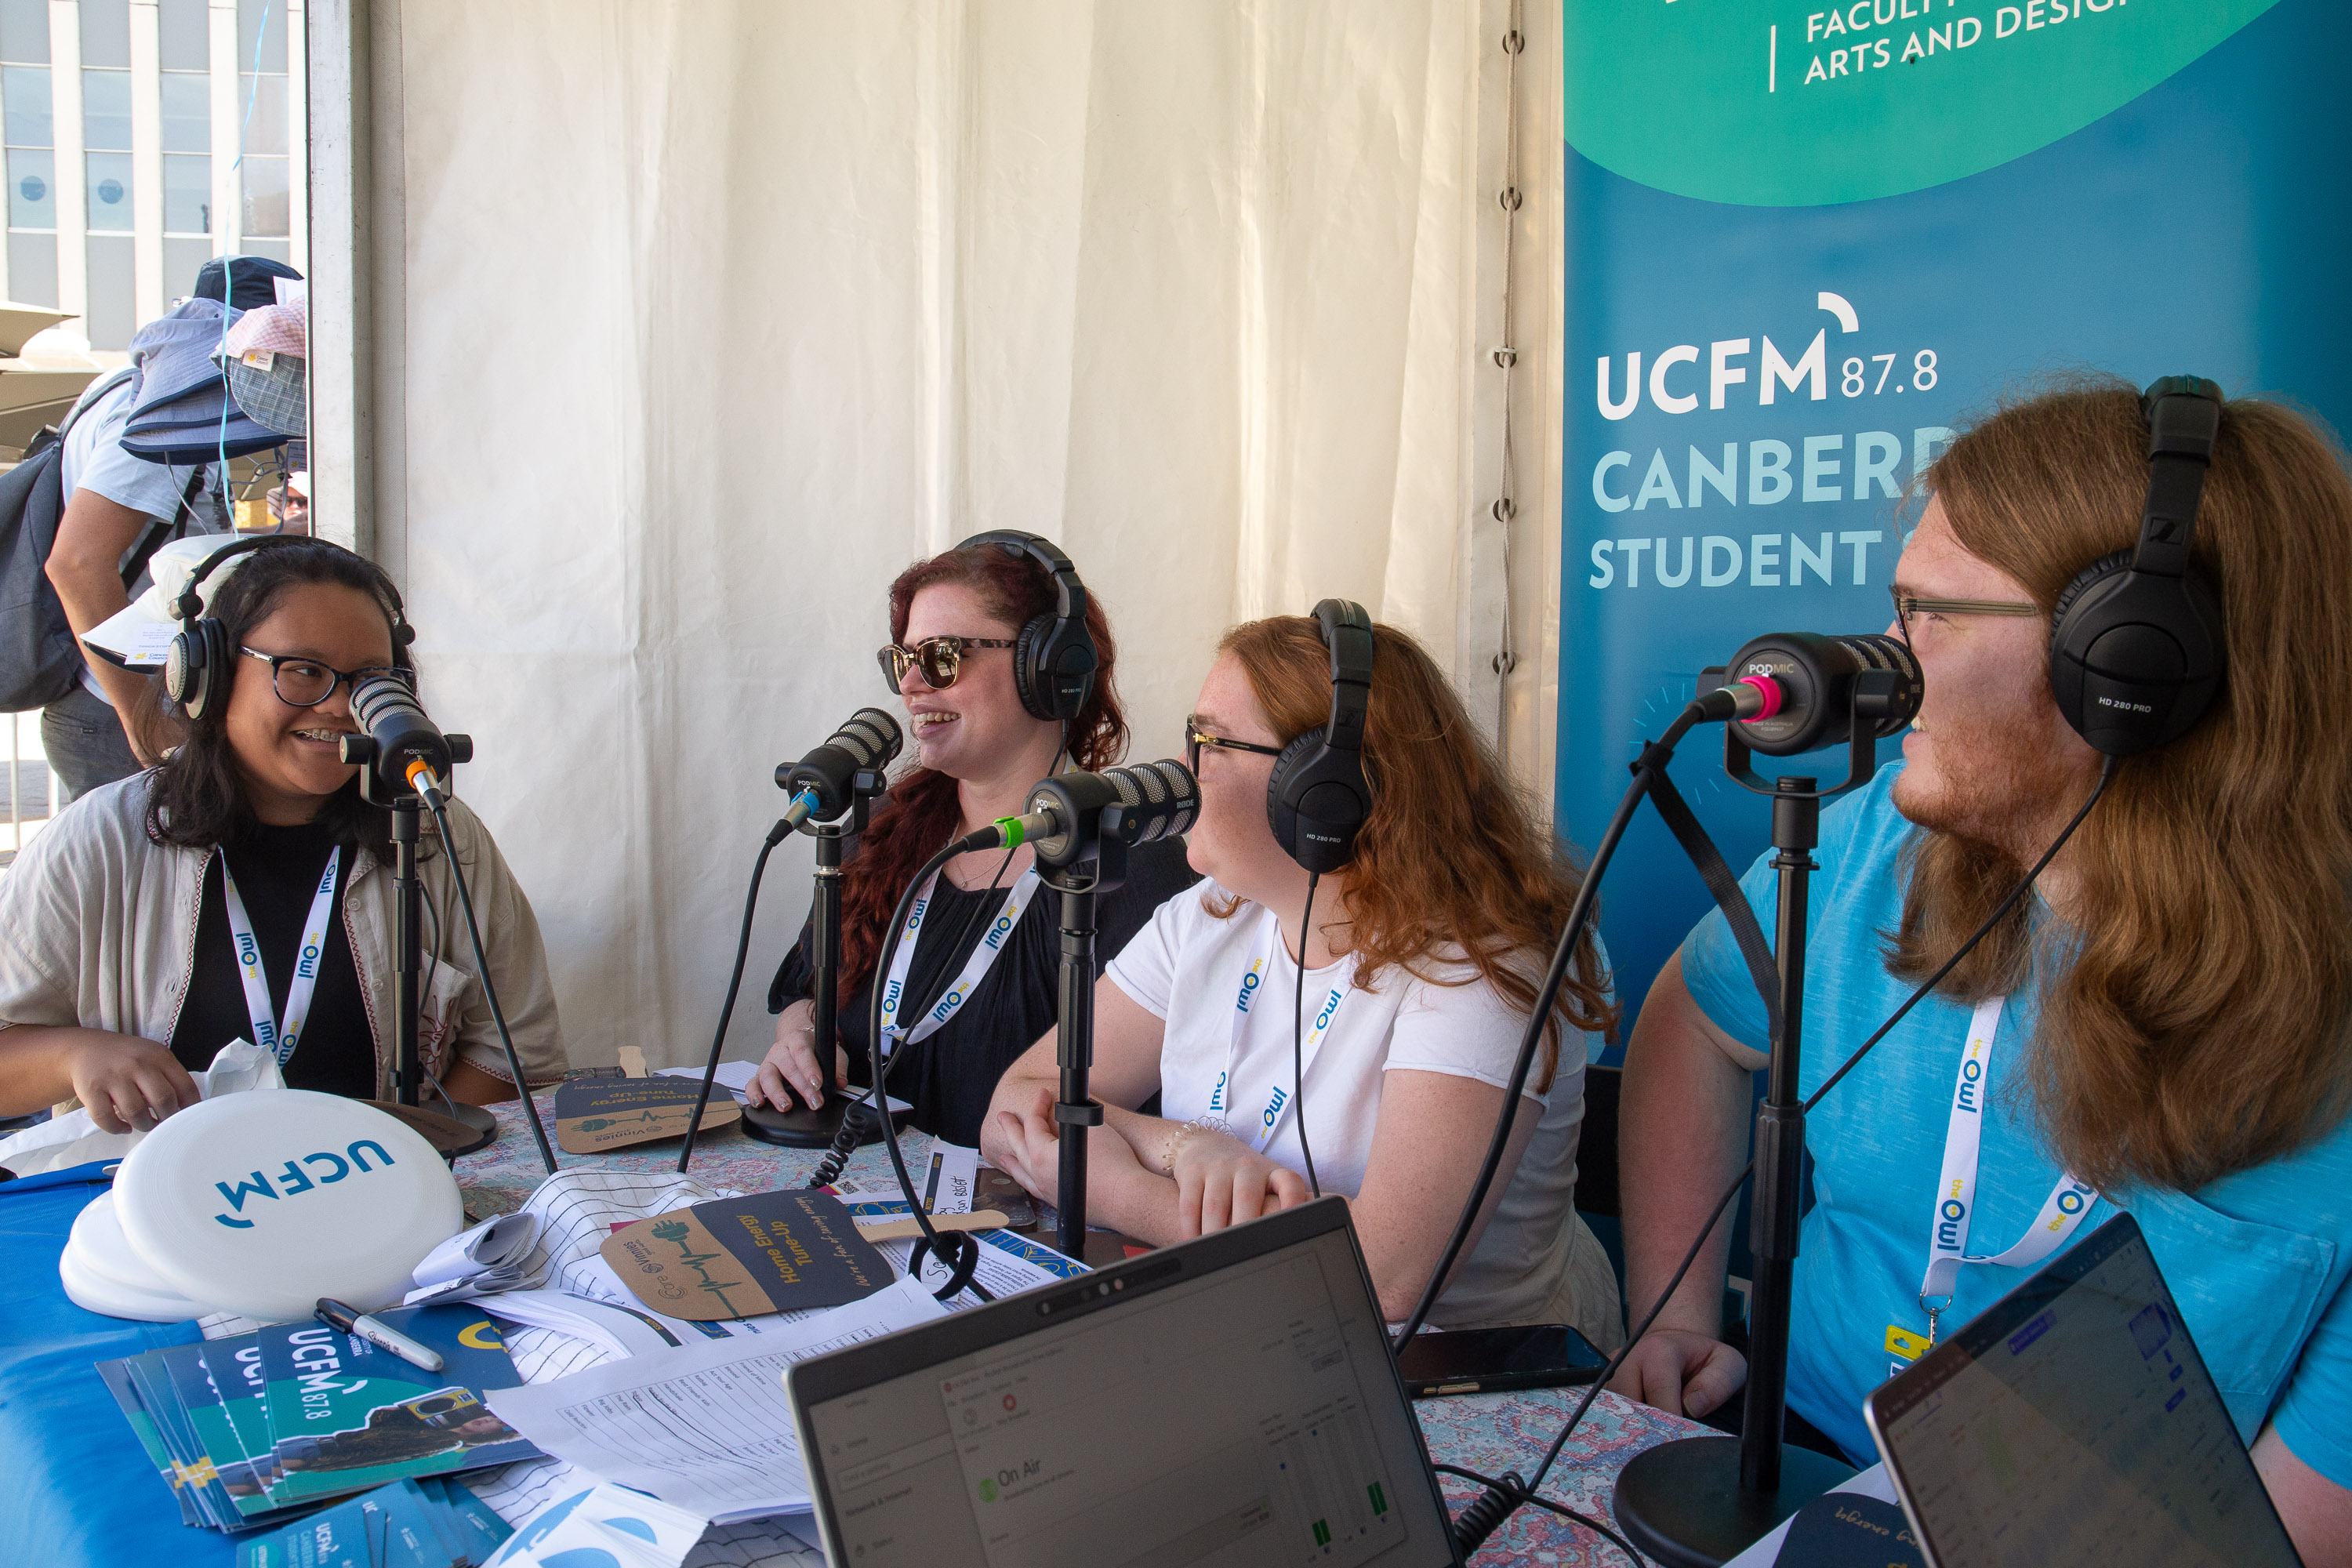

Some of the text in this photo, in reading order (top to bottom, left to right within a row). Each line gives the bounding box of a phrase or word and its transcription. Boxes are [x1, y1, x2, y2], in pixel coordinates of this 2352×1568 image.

[1805, 38, 1890, 85] ARTS
[1900, 16, 1982, 64] AND
[1597, 328, 1937, 420] UCFM 87.8
[1589, 530, 1882, 589] STUDENT
[1749, 663, 1795, 674] PODMIC
[2099, 697, 2151, 713] HD 280 PRO
[1036, 798, 1059, 809] PODMIC
[319, 864, 336, 894] Owl
[908, 899, 927, 930] Owl
[236, 932, 258, 966] Owl
[985, 916, 1011, 950] Owl
[298, 946, 319, 979] Owl
[883, 980, 902, 1013] Owl
[932, 991, 962, 1023] Owl
[1236, 972, 1260, 1013] Owl
[1316, 989, 1342, 1030] Owl
[590, 1096, 647, 1106] Energy
[609, 1090, 677, 1098] Tune-Up
[1957, 1059, 1981, 1113] Owl
[1264, 1086, 1288, 1127] Owl
[595, 1130, 644, 1142] Vinnies
[215, 1140, 395, 1212] UCFM
[924, 1196, 934, 1210] NOTES
[737, 1214, 774, 1247] Energy
[1937, 1200, 1965, 1251] Owl
[623, 1241, 650, 1266] Vinnies
[771, 1221, 815, 1266] Tune-Up
[768, 1247, 800, 1283] Home
[289, 1327, 346, 1420] UCFM 87.8
[997, 1469, 1019, 1487] On
[1023, 1458, 1041, 1477] Air
